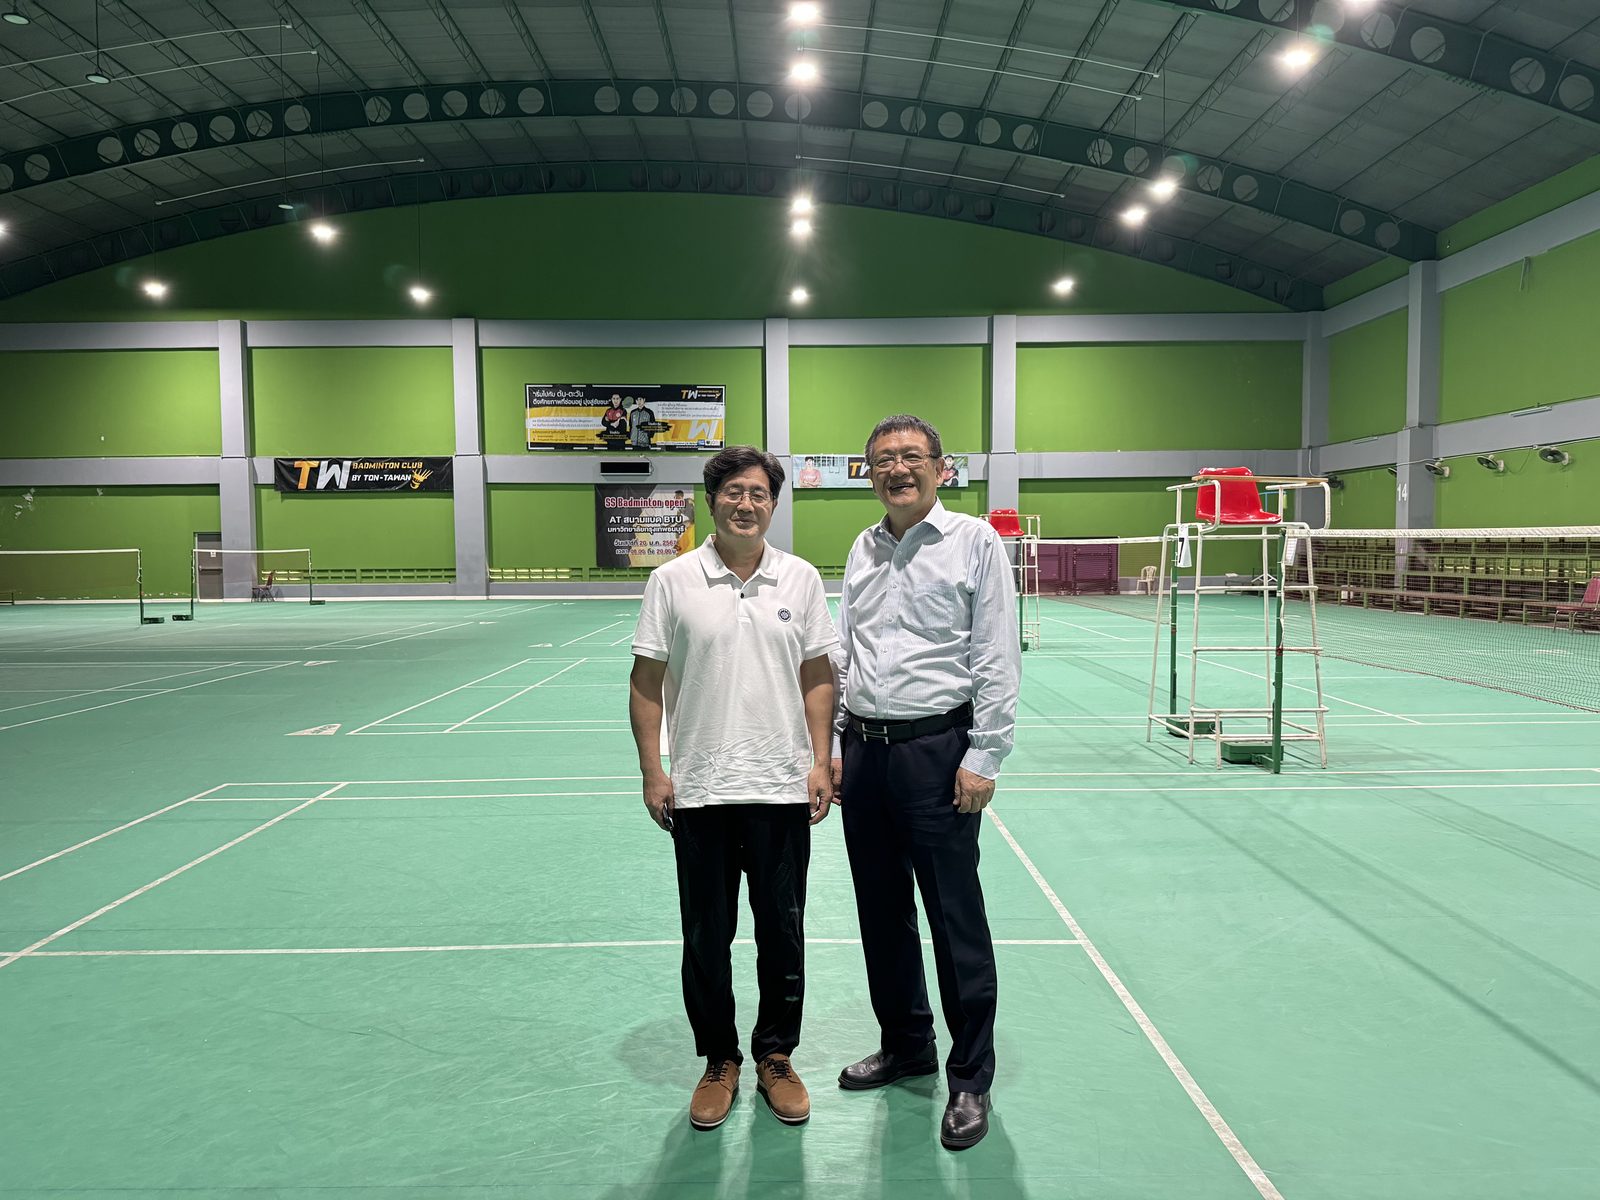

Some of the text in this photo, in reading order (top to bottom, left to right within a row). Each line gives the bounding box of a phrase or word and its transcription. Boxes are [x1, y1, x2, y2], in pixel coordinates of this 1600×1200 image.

[681, 389, 699, 400] TW
[294, 460, 352, 490] TW
[351, 474, 361, 482] BY
[1397, 483, 1408, 502] 14
[605, 496, 685, 510] SS Badminton open
[609, 515, 622, 524] AT
[664, 515, 682, 524] BTU
[607, 525, 685, 535] มหาวิทยาลัยกรุงเทพธนบุรี
[1178, 537, 1185, 564] 7
